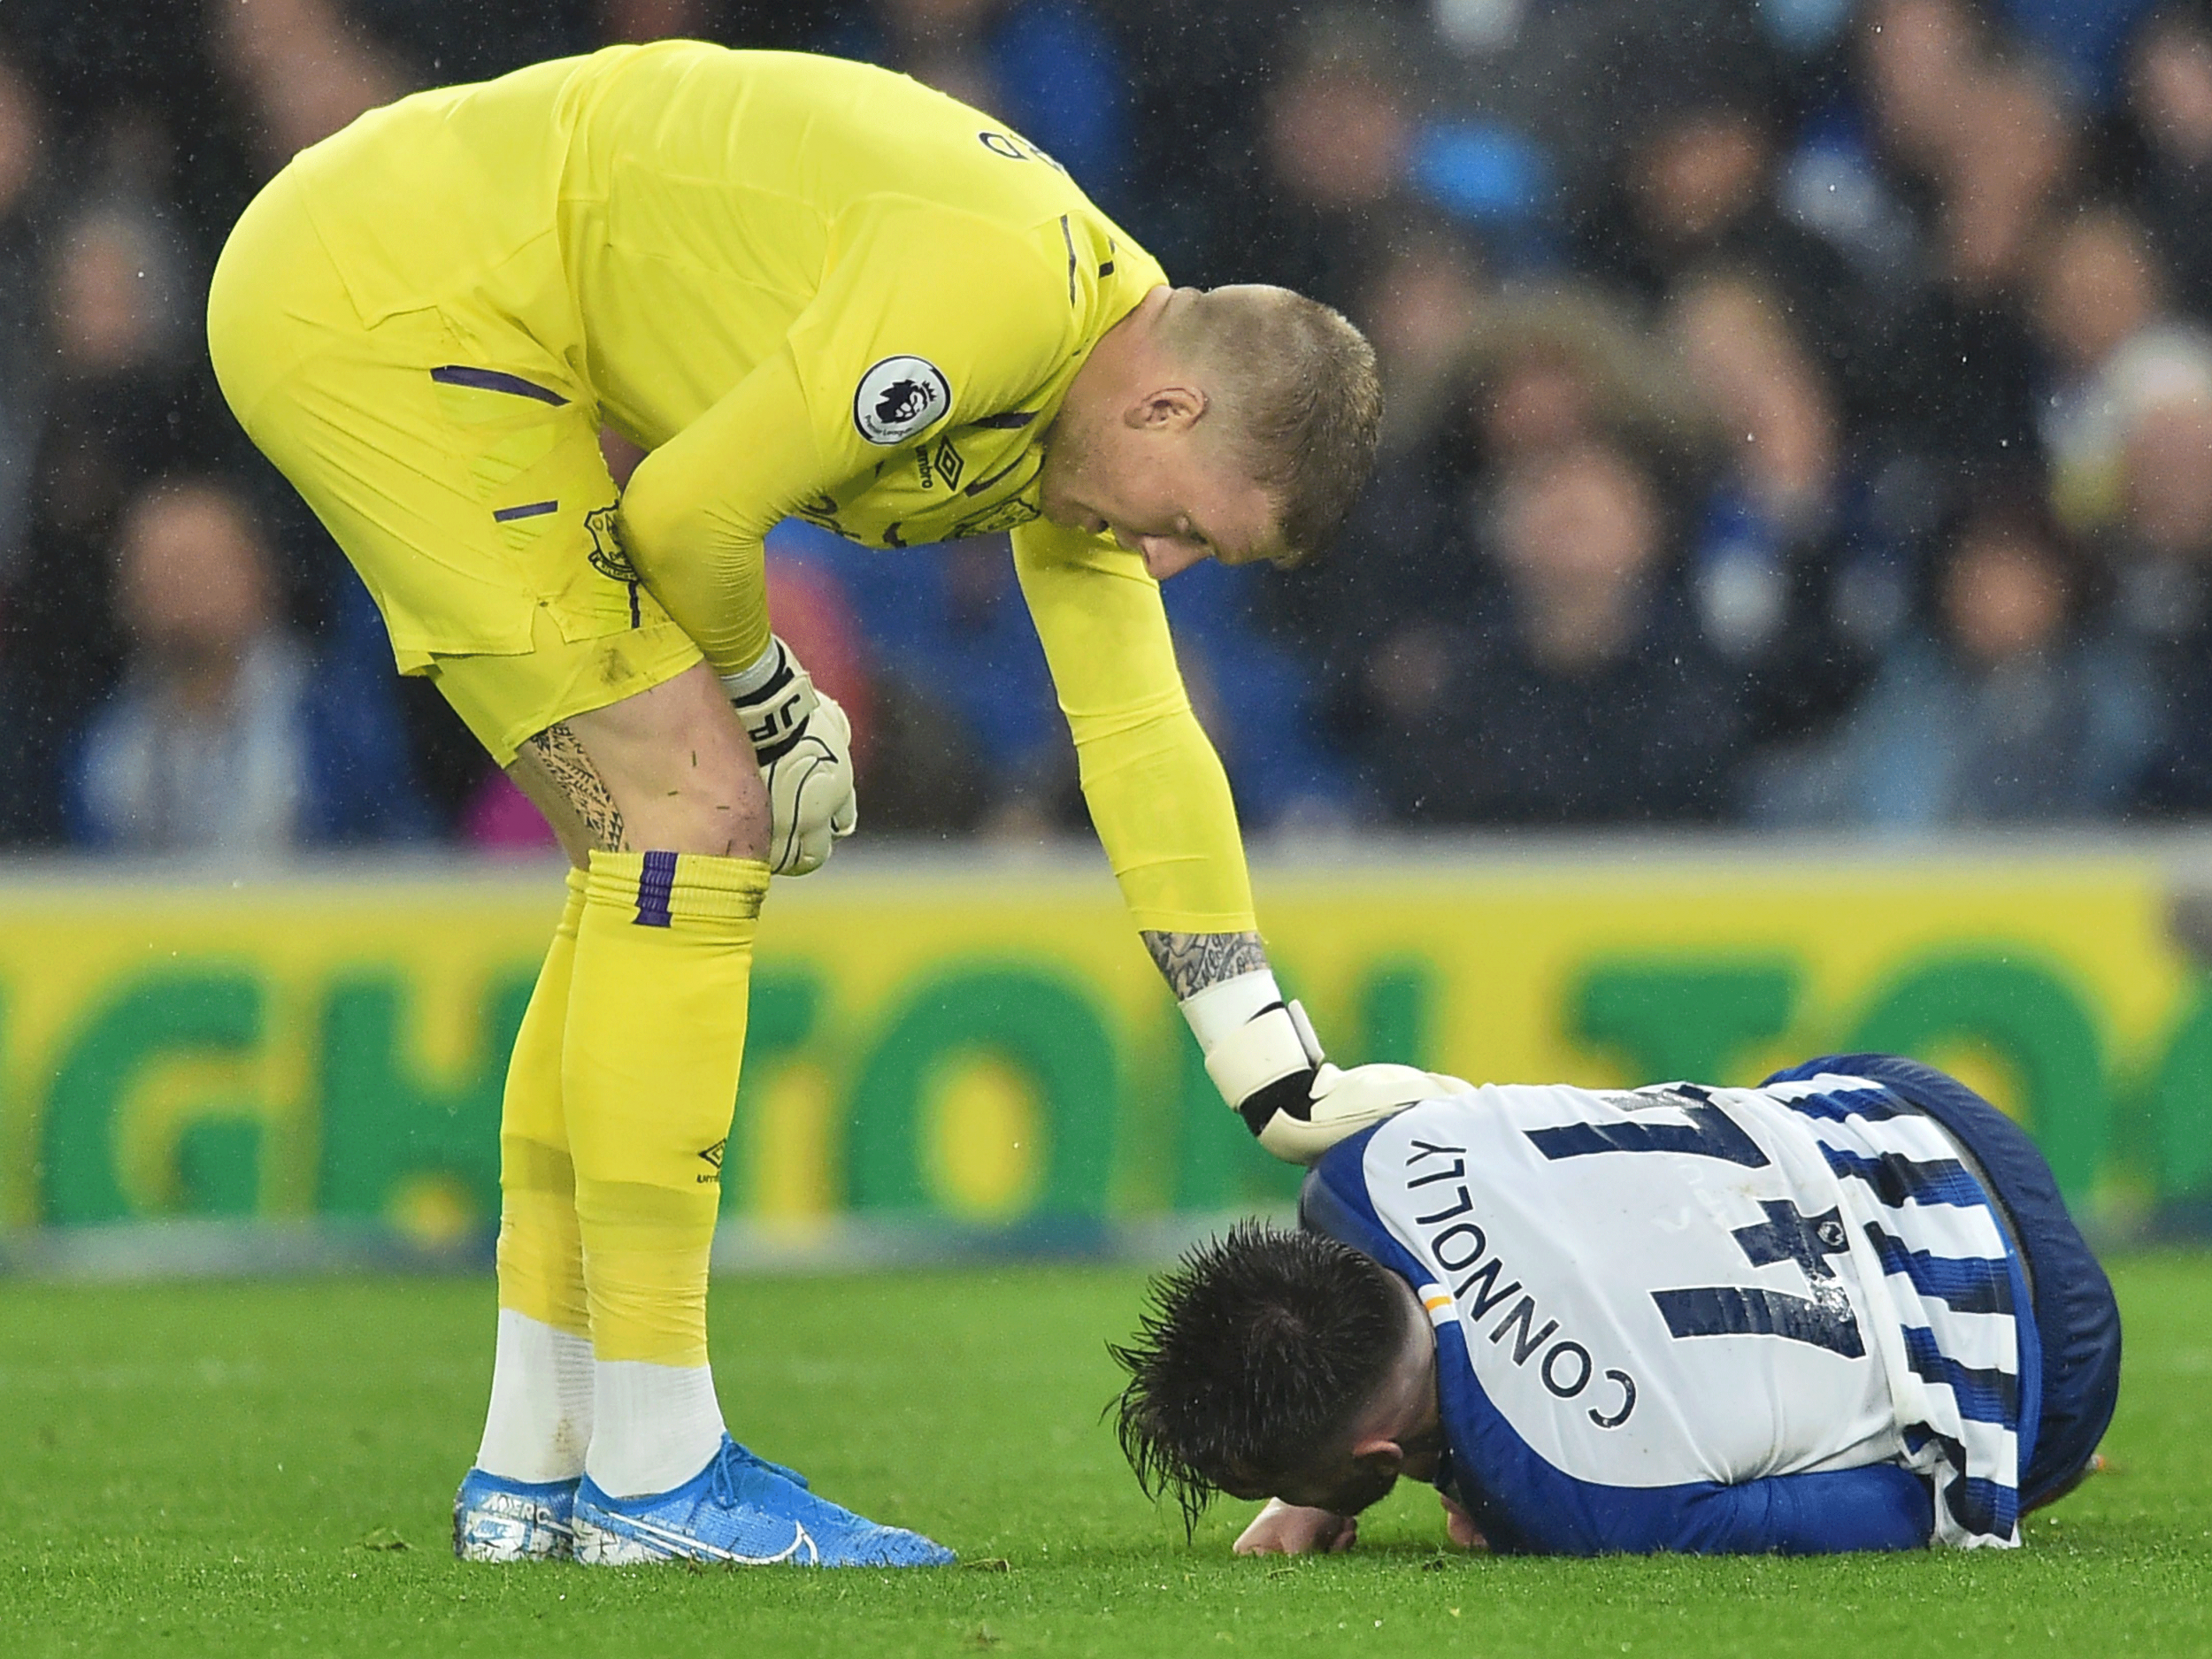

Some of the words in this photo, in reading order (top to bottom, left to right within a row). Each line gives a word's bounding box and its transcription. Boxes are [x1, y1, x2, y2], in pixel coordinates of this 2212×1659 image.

[915, 444, 933, 488] umbro
[749, 693, 801, 741] JP
[1405, 1140, 1637, 1430] CONNOLLY
